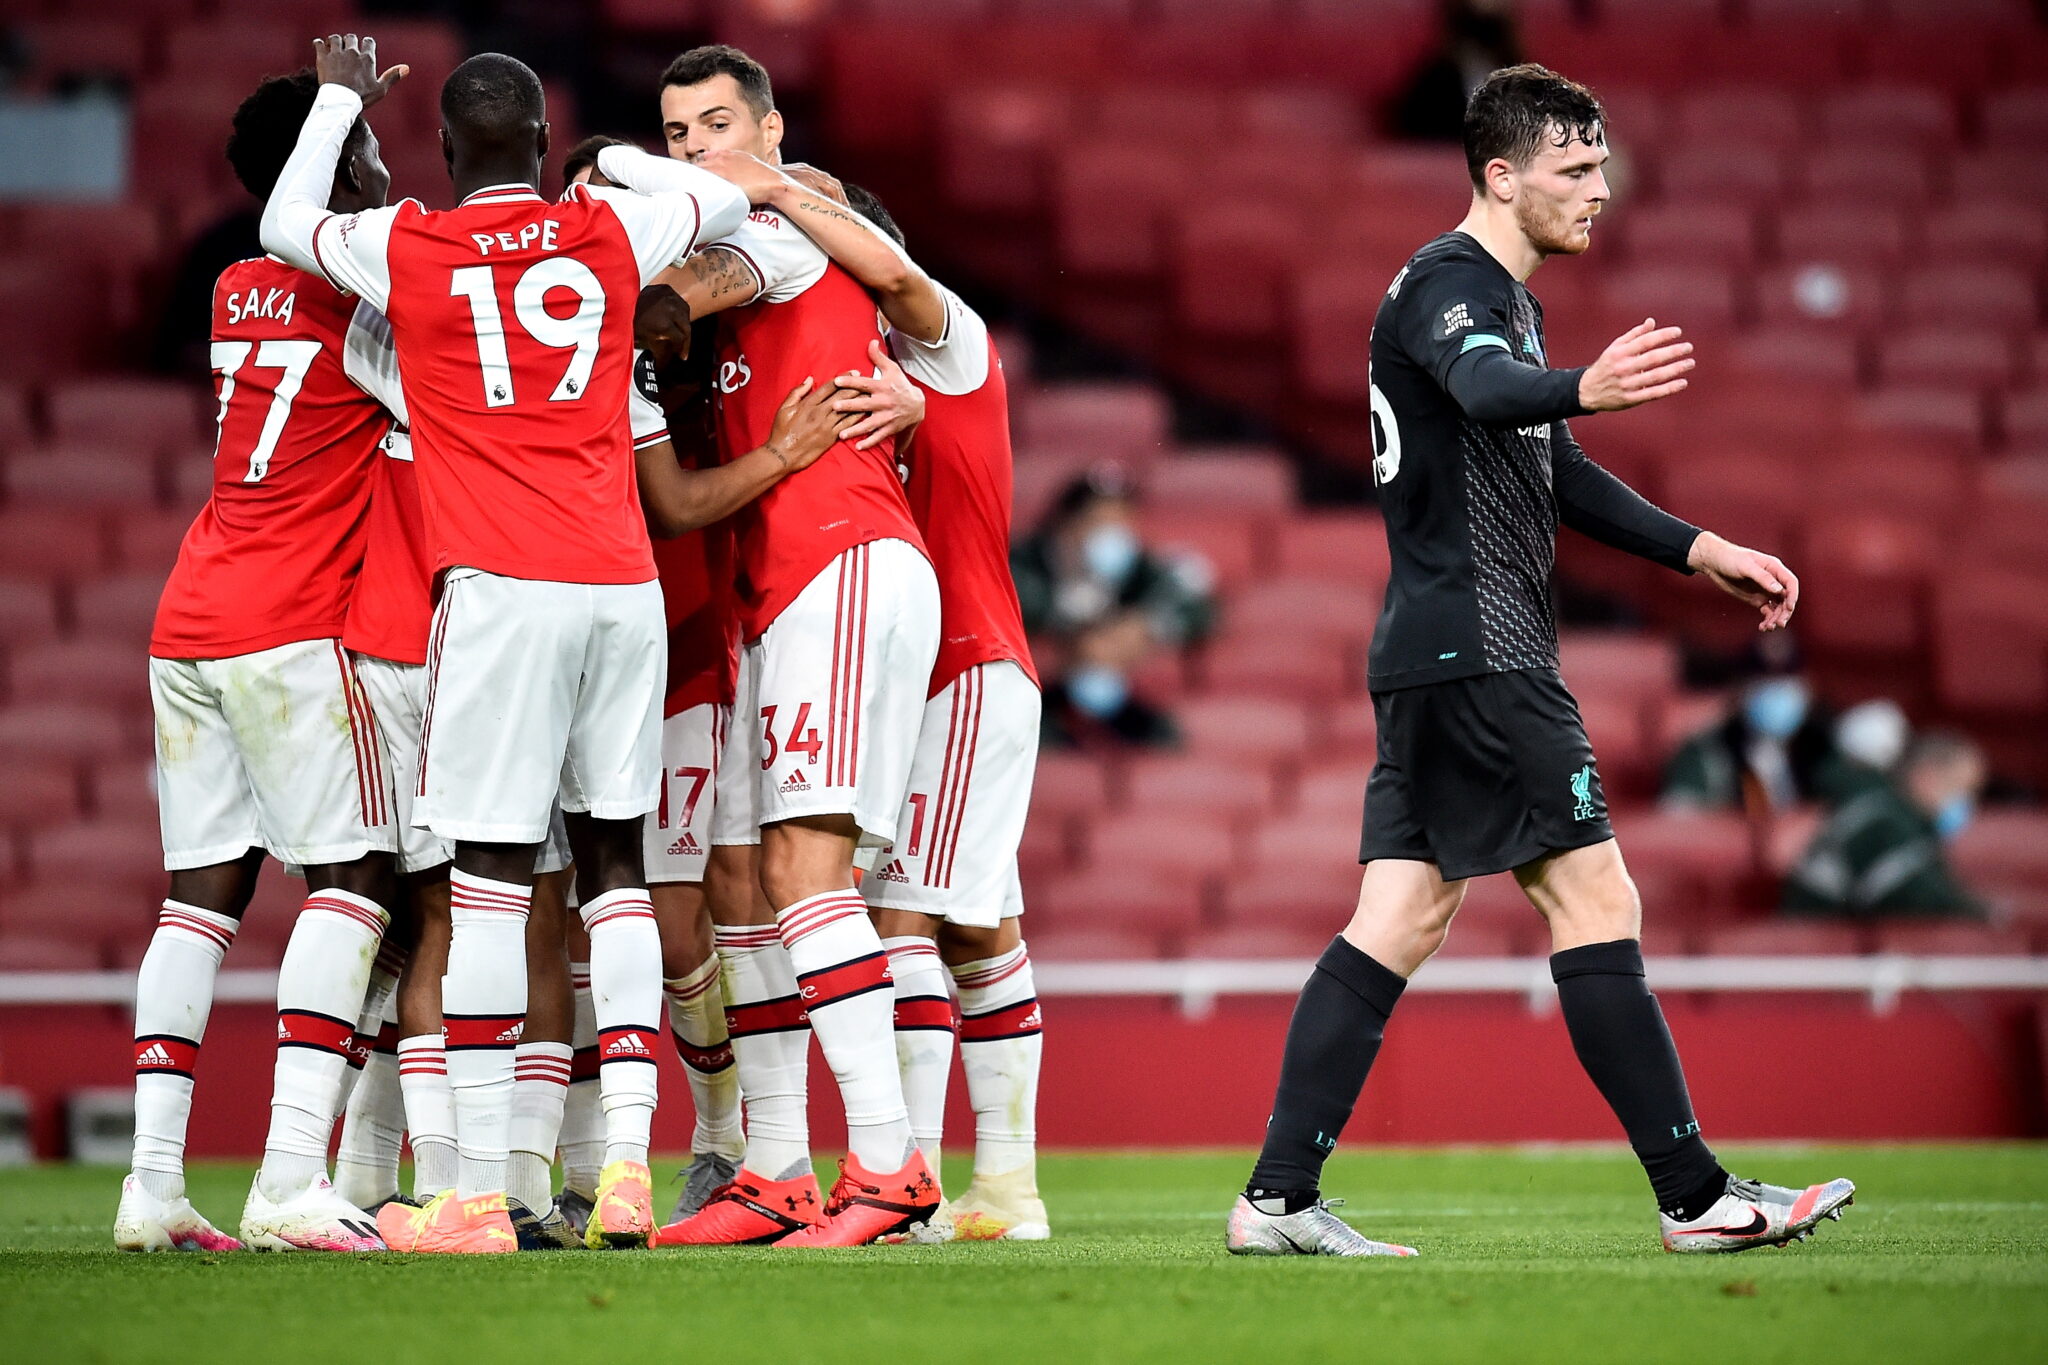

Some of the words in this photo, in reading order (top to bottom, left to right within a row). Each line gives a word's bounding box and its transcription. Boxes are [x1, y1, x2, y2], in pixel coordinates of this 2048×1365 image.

[470, 218, 561, 256] PEPE
[226, 287, 296, 326] SAKA
[450, 256, 607, 409] 19
[1444, 317, 1475, 336] MATTER
[210, 340, 324, 483] 77
[760, 702, 824, 771] 34
[658, 767, 711, 829] 17
[779, 783, 812, 793] adidas
[666, 846, 703, 855] adidas
[876, 871, 910, 883] adidas
[136, 1057, 175, 1065] adidas
[606, 1046, 650, 1055] adidas
